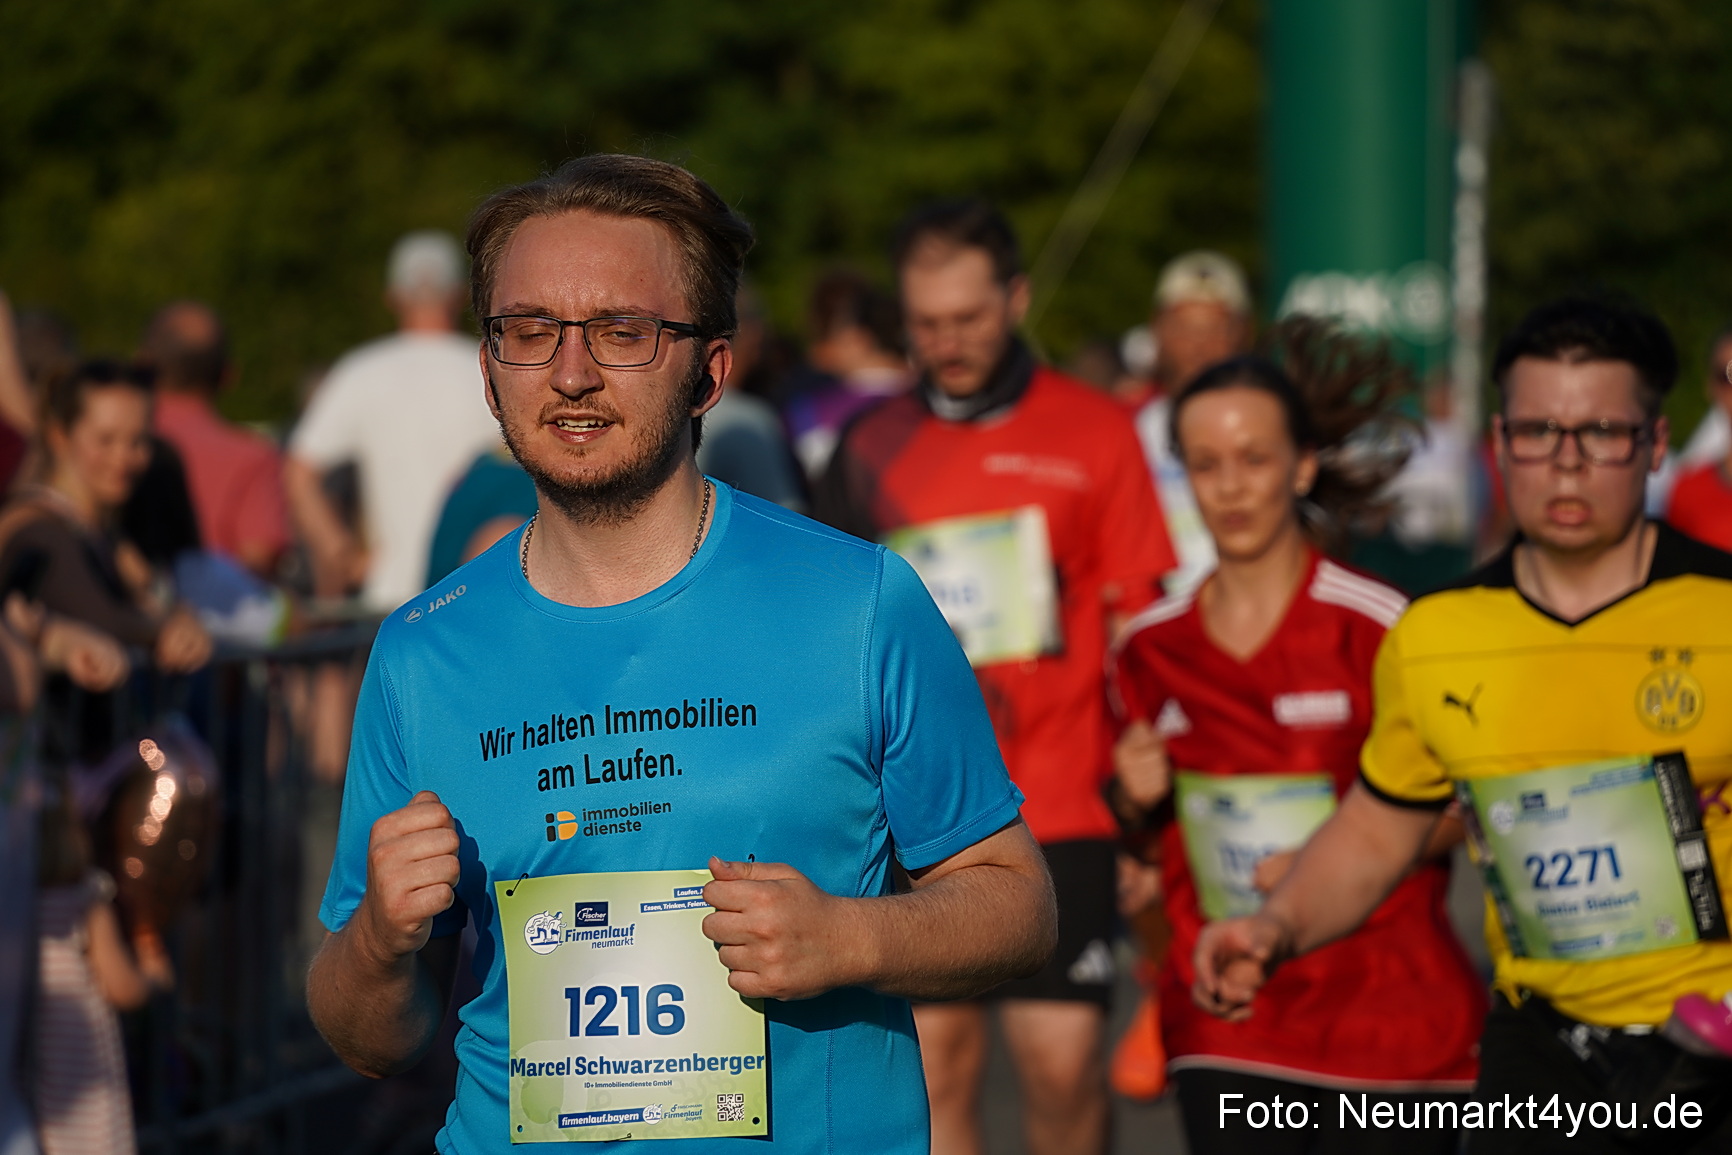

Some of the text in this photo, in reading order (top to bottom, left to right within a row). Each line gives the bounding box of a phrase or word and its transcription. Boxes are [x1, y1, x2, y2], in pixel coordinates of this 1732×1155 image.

[428, 584, 467, 613] JAKO
[479, 698, 758, 761] Wir halten Immobilien
[537, 748, 683, 792] am Laufen.
[582, 801, 671, 822] immobilien
[583, 820, 641, 836] dienste
[1524, 846, 1621, 889] 2271
[582, 911, 607, 919] Fischer
[643, 904, 662, 912] Essen,
[565, 923, 635, 942] Firmenlauf
[591, 937, 634, 949] neumarkt
[564, 983, 686, 1037] 1216
[510, 1053, 765, 1077] Marcel Schwarzenberger
[595, 1080, 652, 1088] Immobiliendienste
[561, 1112, 640, 1126] firmenlauf.bayern
[663, 1109, 703, 1119] Firmenlauf
